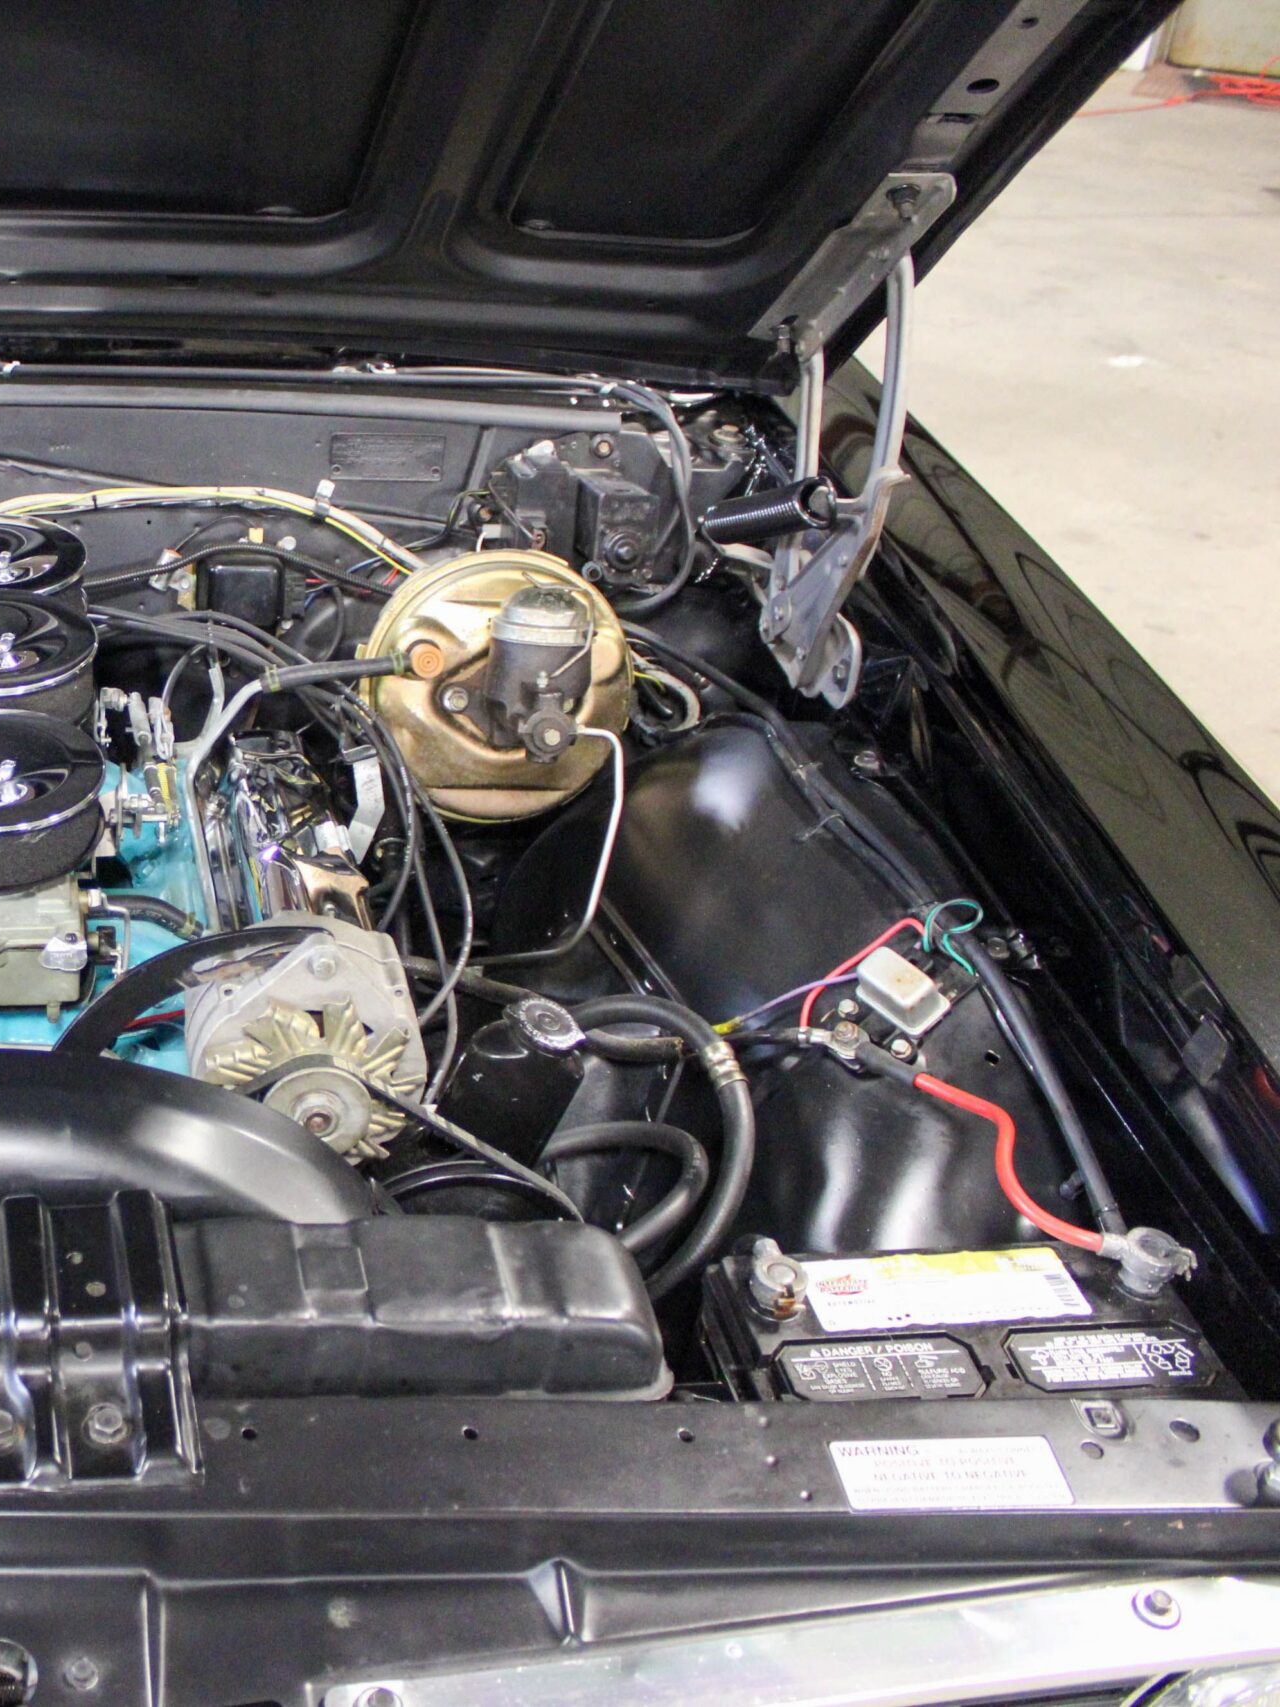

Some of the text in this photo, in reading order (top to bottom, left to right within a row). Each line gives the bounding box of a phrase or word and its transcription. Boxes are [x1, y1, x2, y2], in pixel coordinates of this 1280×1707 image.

[821, 1345, 874, 1357] DANGER
[885, 1342, 934, 1353] POISON
[837, 1445, 919, 1457] WARNING
